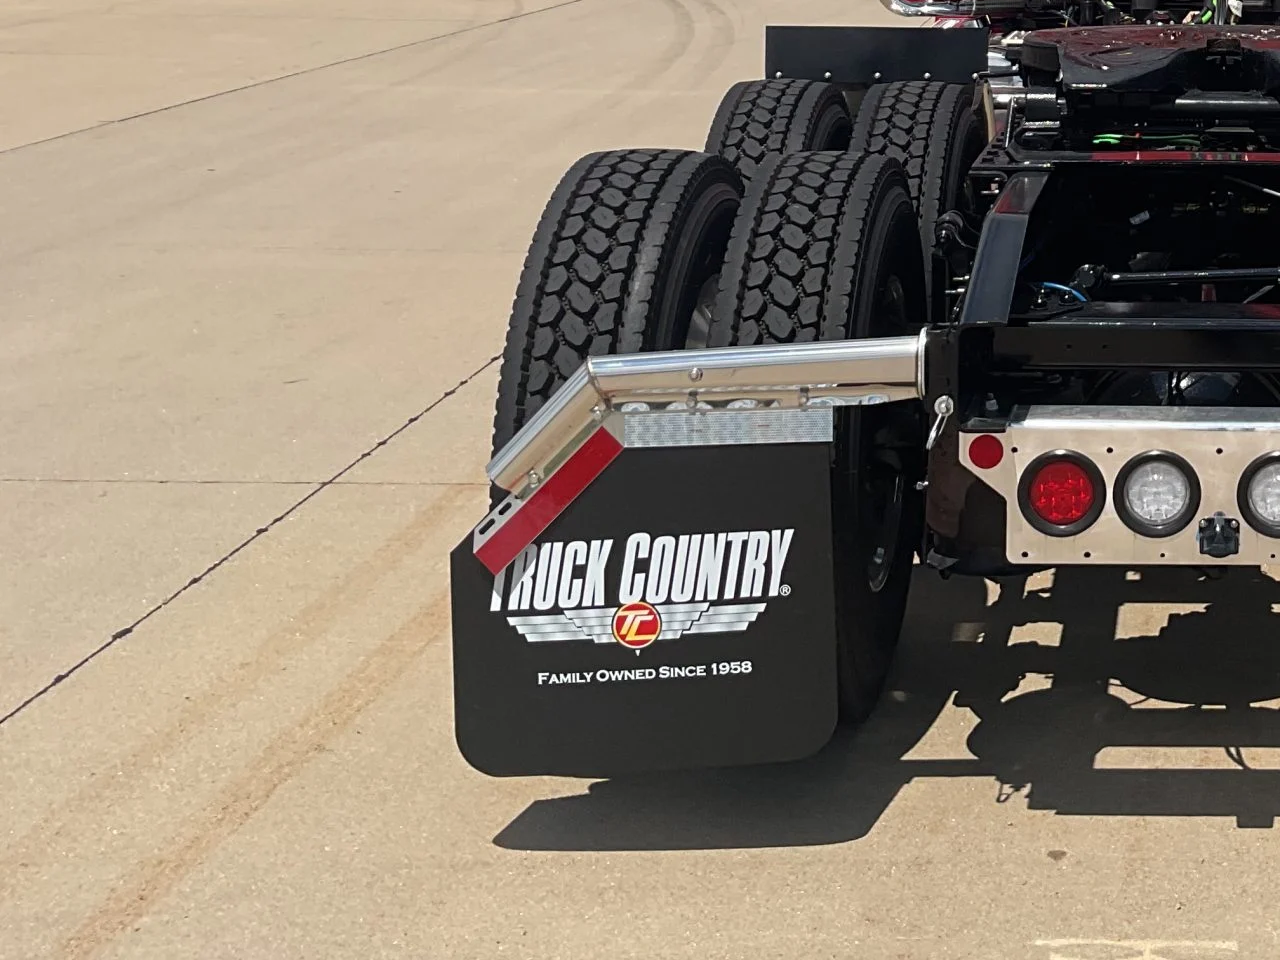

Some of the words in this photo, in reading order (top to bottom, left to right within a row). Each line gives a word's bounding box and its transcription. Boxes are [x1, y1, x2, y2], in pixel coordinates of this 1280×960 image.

[537, 670, 594, 685] FAMILY
[596, 668, 656, 683] OWNED
[658, 664, 706, 679] SINCE
[711, 660, 753, 675] 1958
